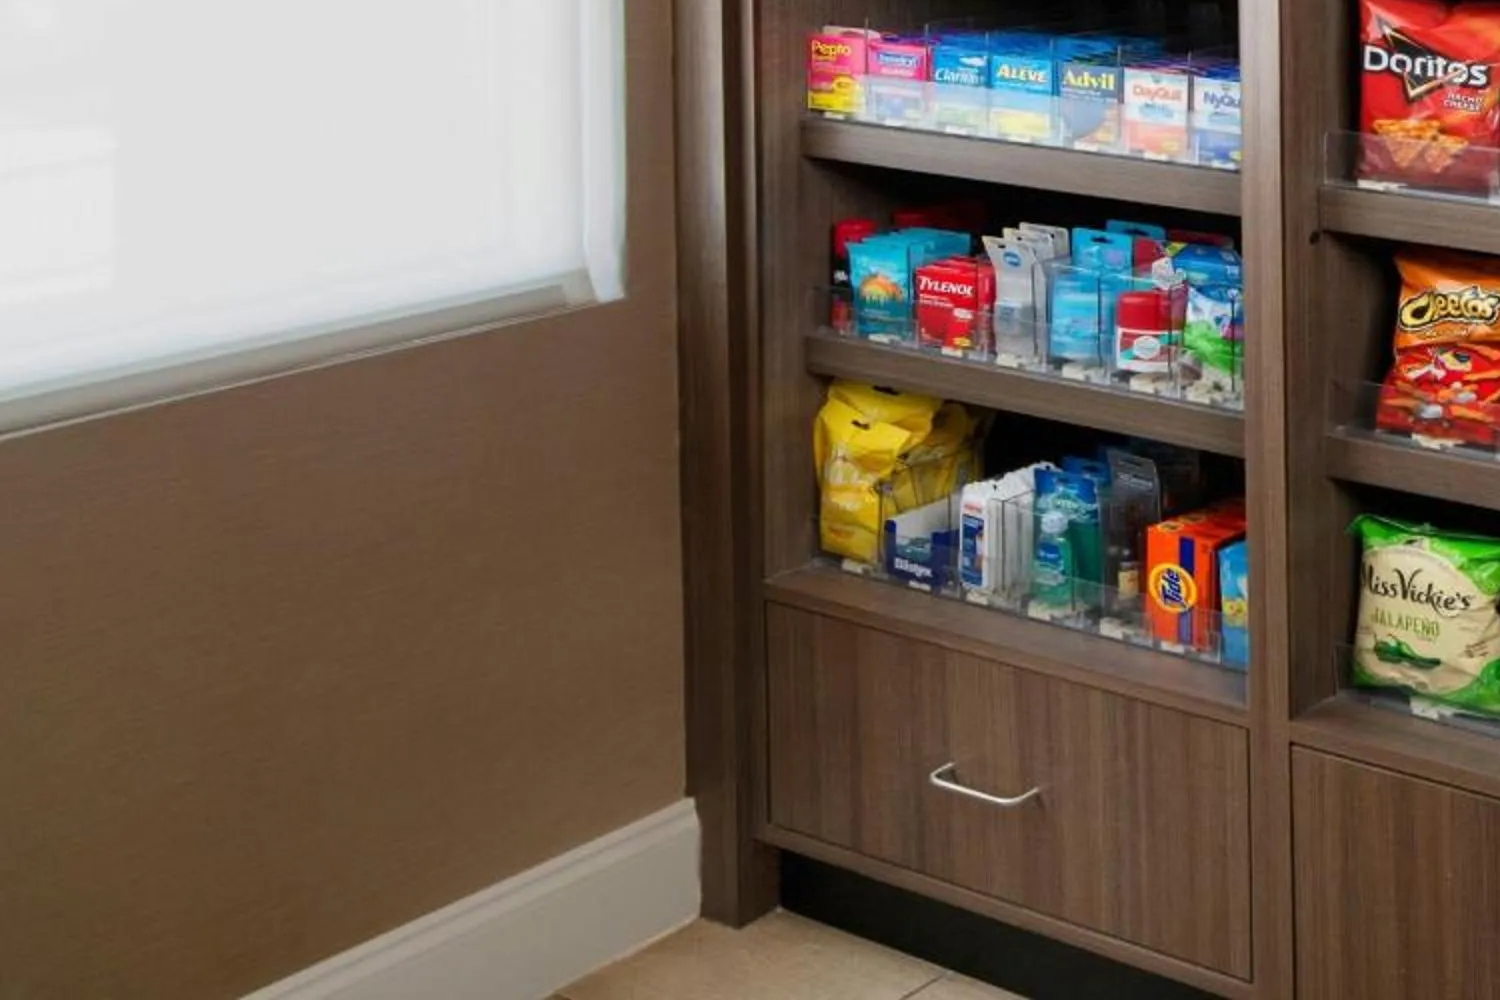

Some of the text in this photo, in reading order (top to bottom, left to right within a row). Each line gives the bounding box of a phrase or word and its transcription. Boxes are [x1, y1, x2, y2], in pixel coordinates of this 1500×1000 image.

[1064, 69, 1115, 91] Advil
[1362, 45, 1489, 86] Doritos
[919, 276, 974, 297] TYLENOL
[1393, 568, 1472, 617] Vickie's
